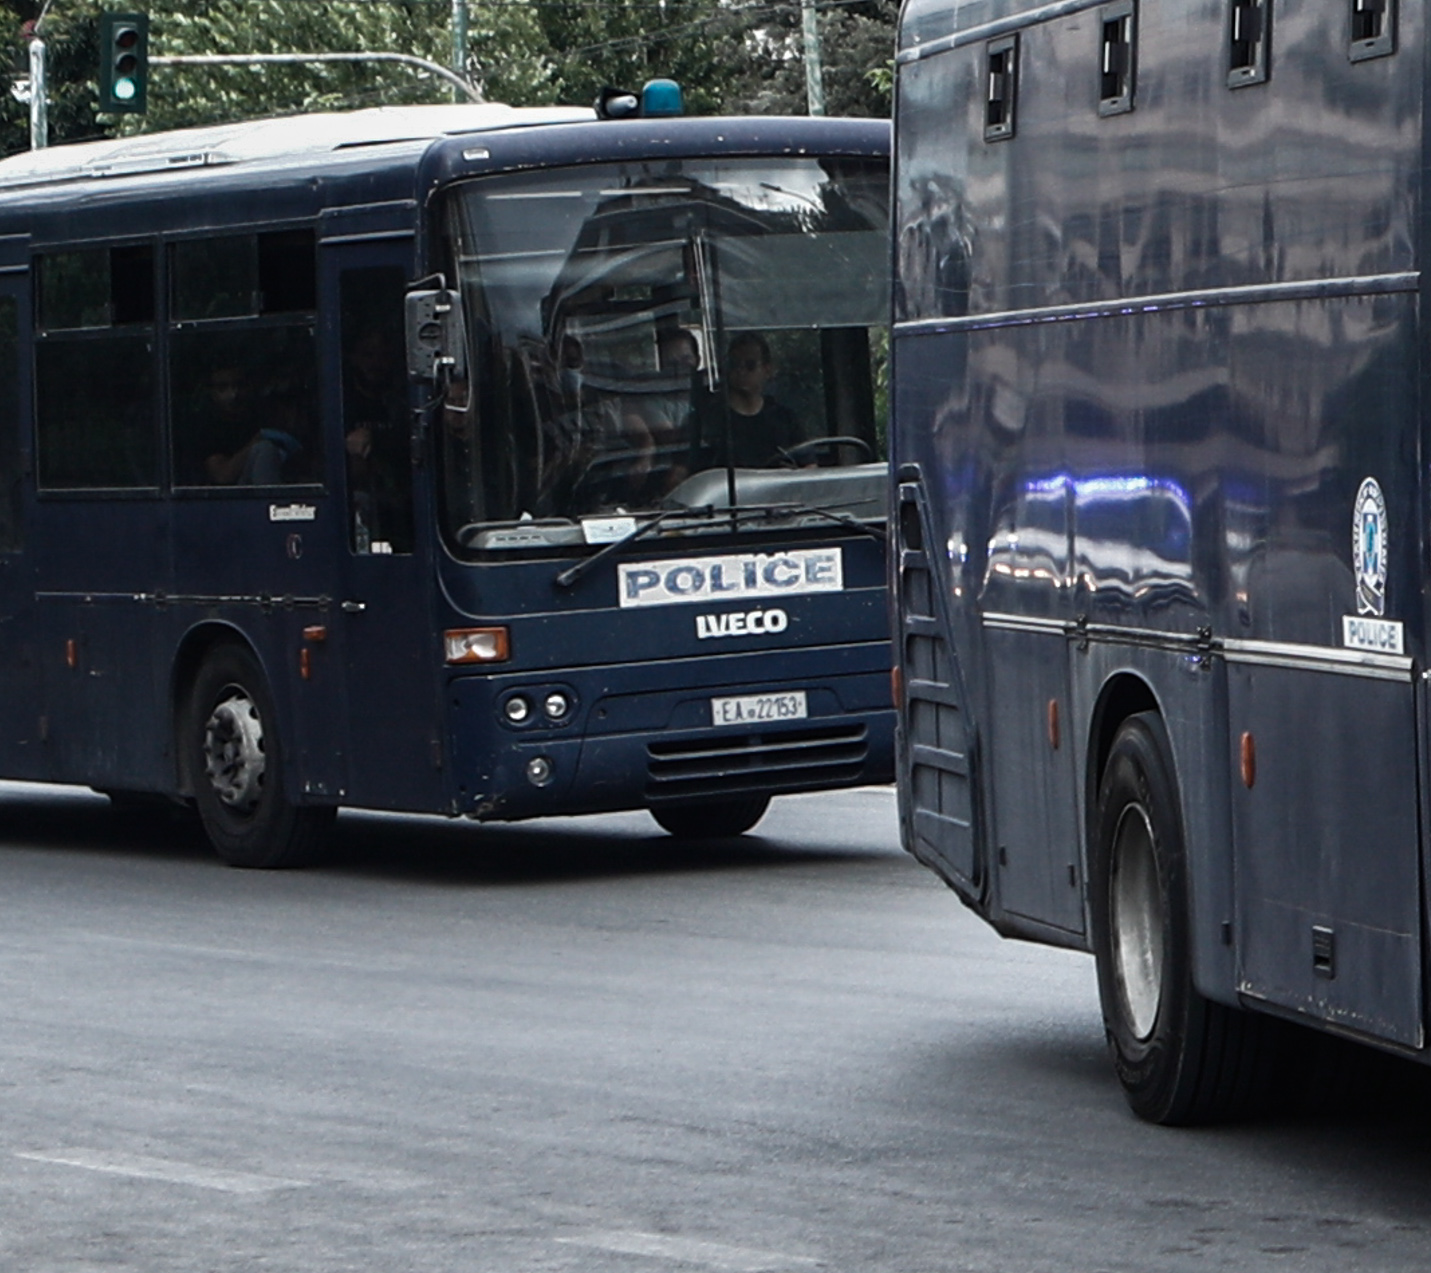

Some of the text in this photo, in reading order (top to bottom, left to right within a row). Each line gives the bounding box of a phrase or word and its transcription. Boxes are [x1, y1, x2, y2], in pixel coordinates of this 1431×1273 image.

[625, 555, 836, 600] POLICE
[695, 609, 788, 639] IVECO
[1348, 620, 1397, 650] POLICE
[756, 695, 797, 719] 22153
